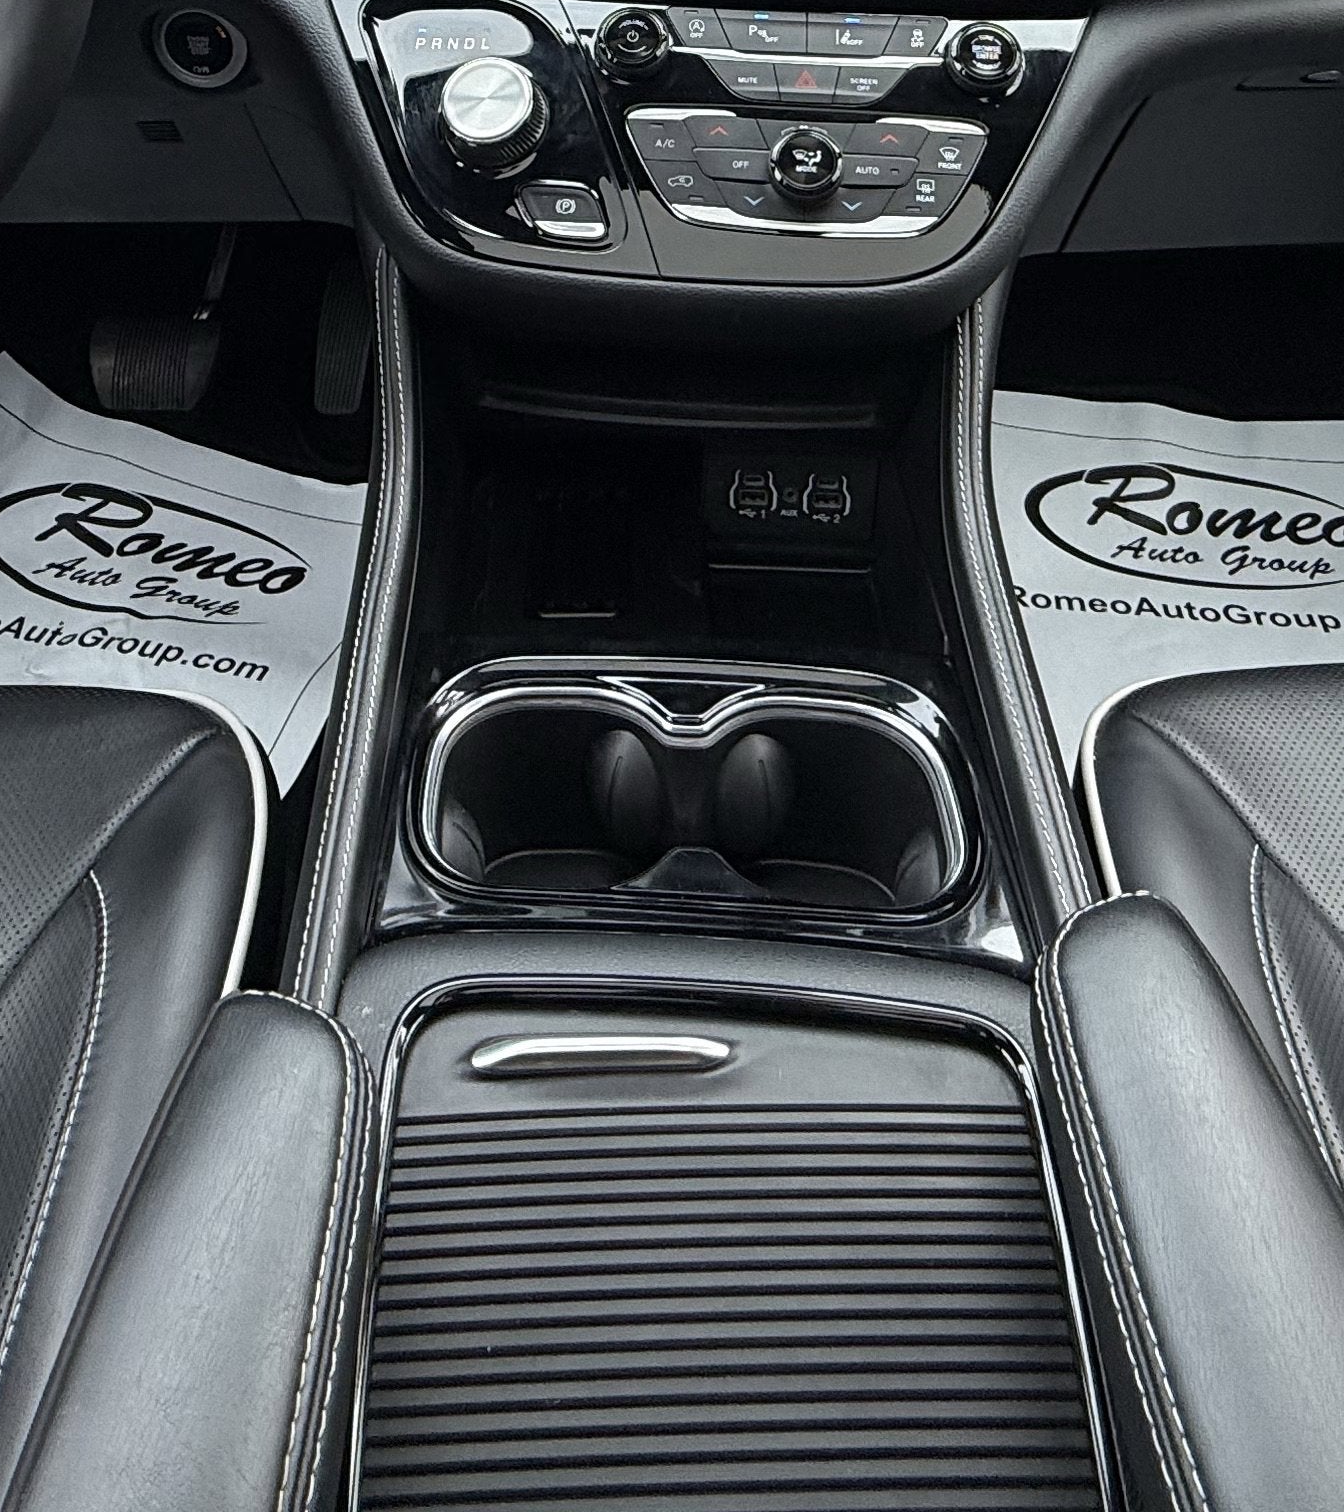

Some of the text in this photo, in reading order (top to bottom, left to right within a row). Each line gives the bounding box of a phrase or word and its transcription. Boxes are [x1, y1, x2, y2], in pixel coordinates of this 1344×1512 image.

[910, 40, 924, 48] OFF
[850, 77, 879, 85] SCREEN
[655, 138, 675, 149] A/C
[732, 160, 750, 169] OFF
[795, 165, 817, 173] MODE
[937, 161, 963, 171] FRONT
[855, 165, 880, 176] AUTO
[915, 194, 935, 203] REAR
[780, 509, 798, 518] AUX
[833, 514, 841, 524] 2
[36, 482, 308, 594] Romeo
[1111, 536, 1335, 581] Auto Group
[32, 556, 241, 617] Auto Group
